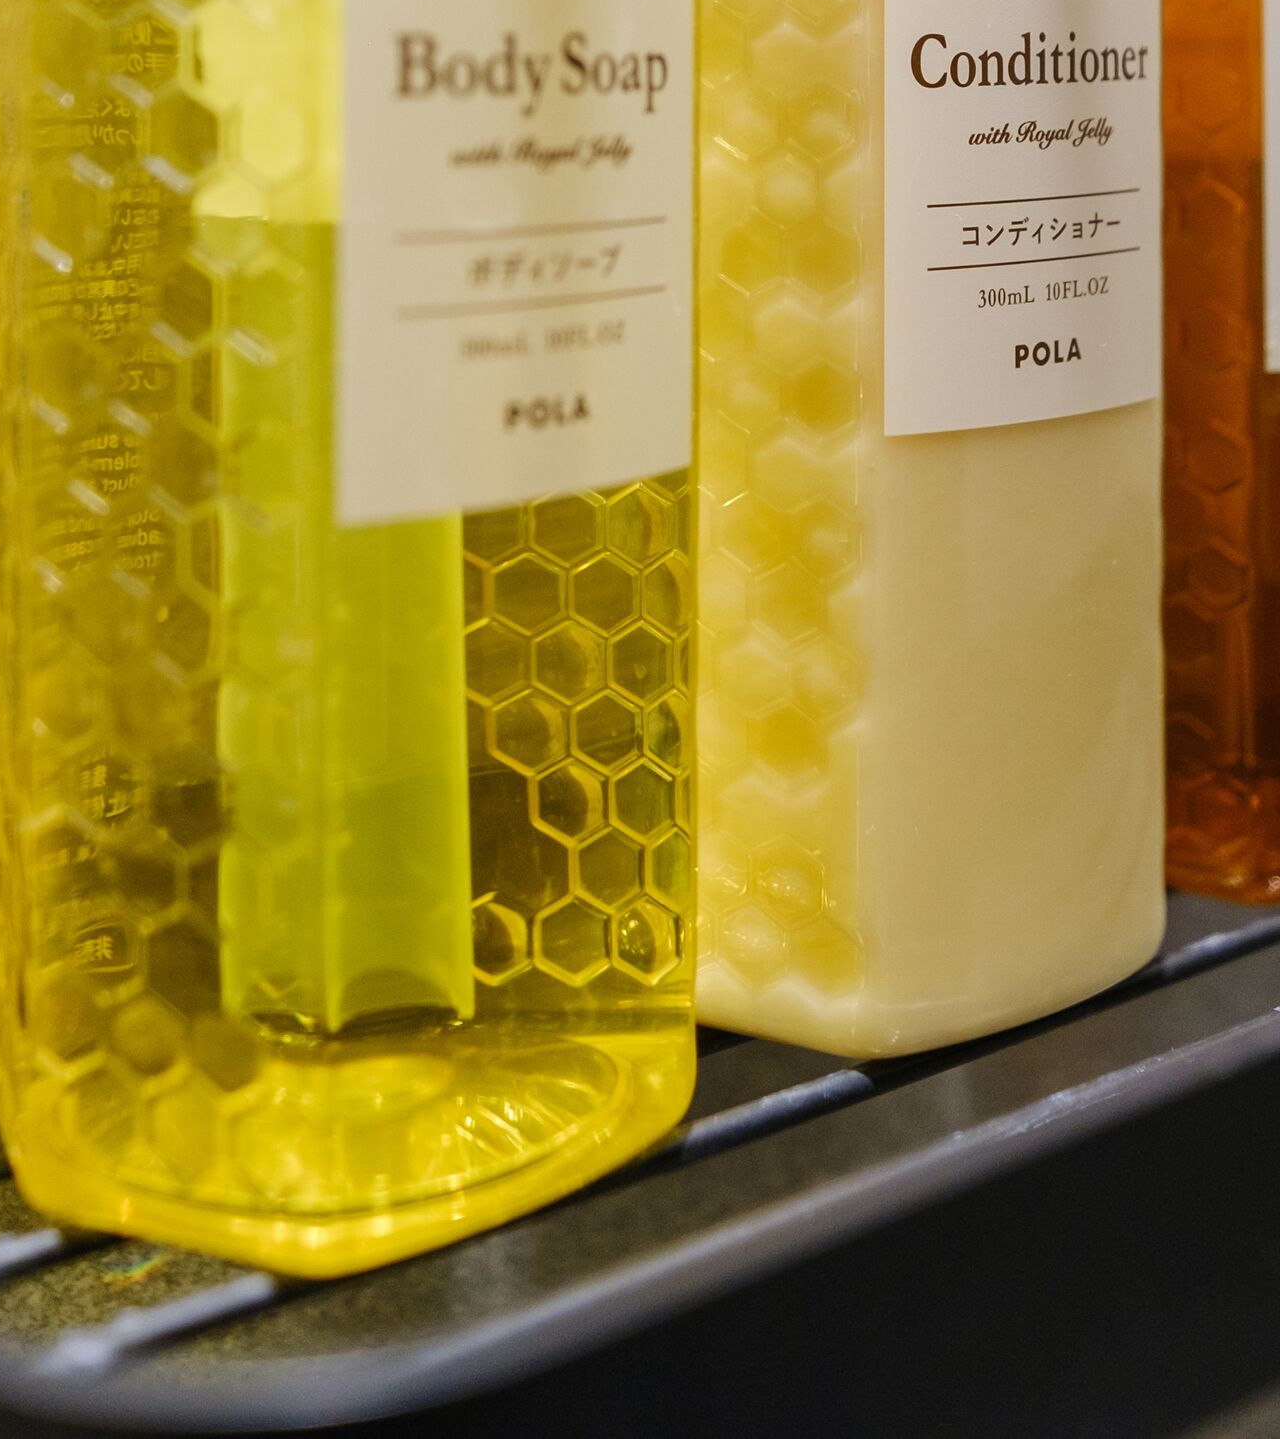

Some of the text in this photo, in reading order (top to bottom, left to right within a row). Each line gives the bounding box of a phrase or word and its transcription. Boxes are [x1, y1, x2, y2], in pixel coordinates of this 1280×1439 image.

[394, 31, 669, 117] Body Soap
[910, 30, 1148, 89] Conditioner
[968, 117, 1114, 150] with Royal Jelly
[962, 211, 1120, 247] コンディショナー
[977, 276, 1109, 309] 300mL 10FL.OZ
[1014, 337, 1082, 369] POLA
[502, 392, 591, 432] POLA
